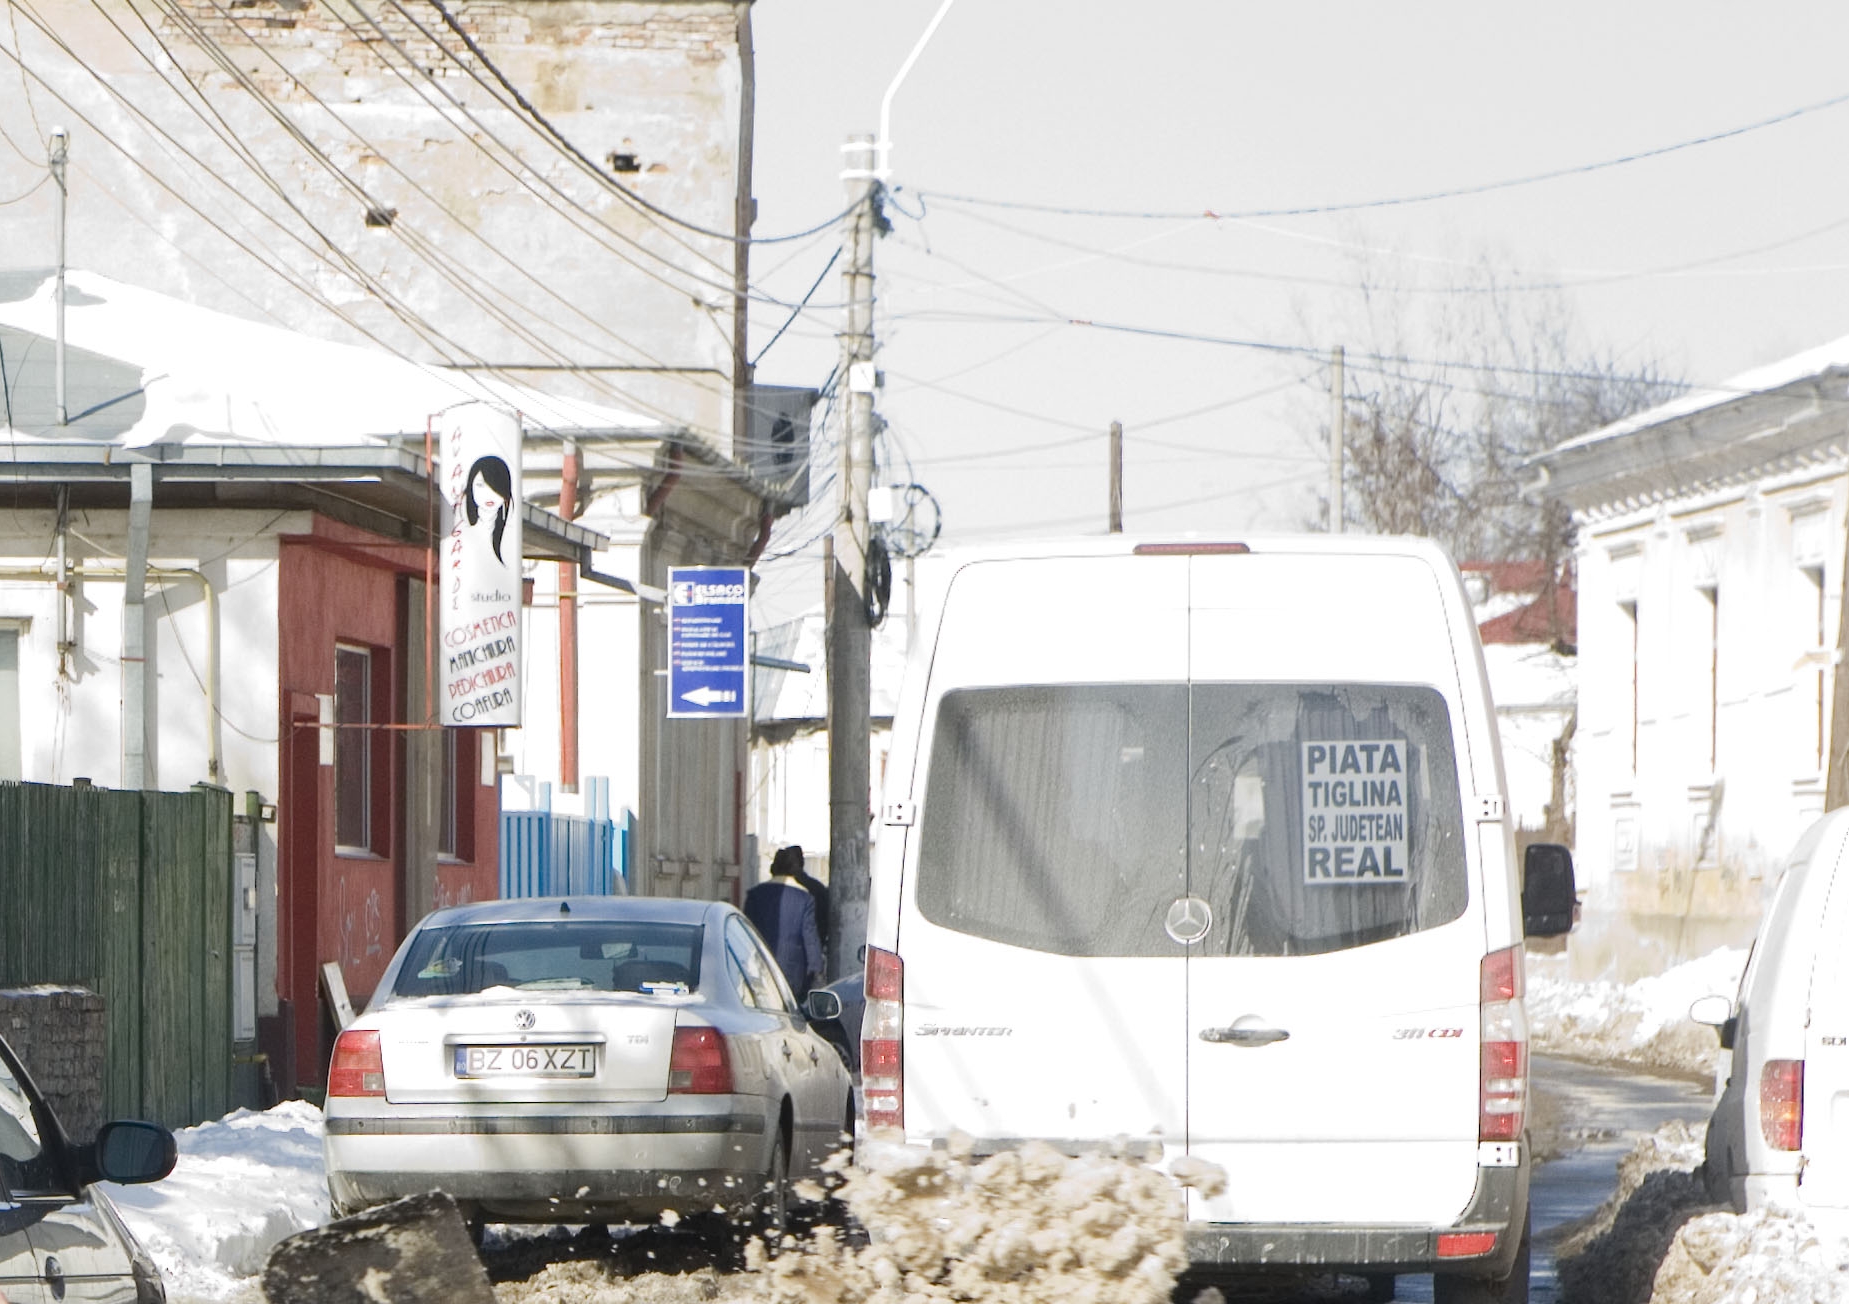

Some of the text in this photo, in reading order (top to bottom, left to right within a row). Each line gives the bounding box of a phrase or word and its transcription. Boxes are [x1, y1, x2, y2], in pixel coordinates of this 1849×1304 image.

[471, 589, 512, 602] studio
[444, 610, 517, 648] COSMETICA
[452, 687, 513, 722] COAFURA
[1307, 744, 1402, 774] PIATA
[1308, 780, 1402, 808] TIGLINA
[1308, 813, 1403, 842] SP. JUDETEAN
[1308, 846, 1404, 878] REAL
[468, 1049, 591, 1071] BZ 06 XZT
